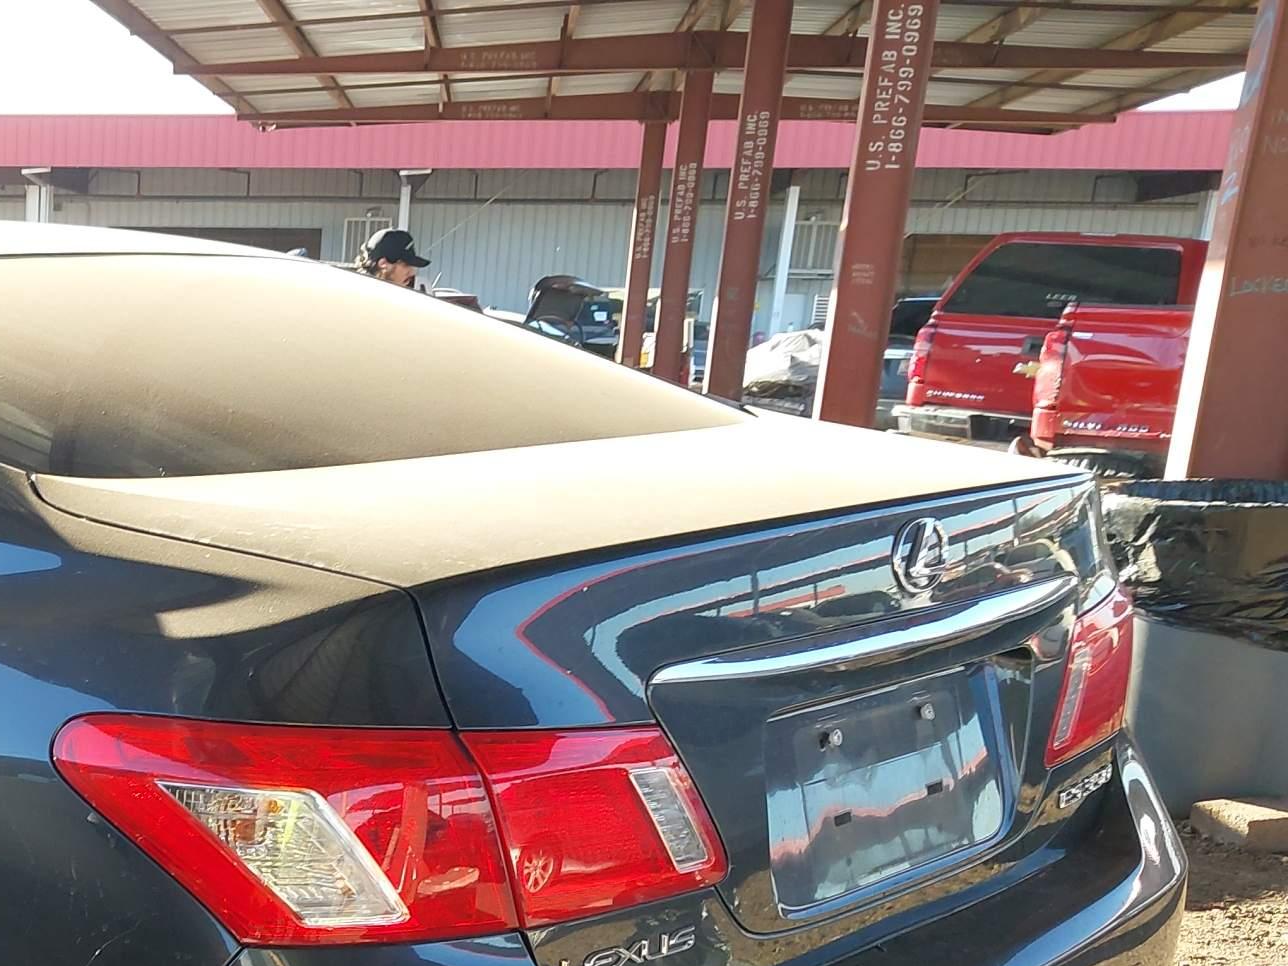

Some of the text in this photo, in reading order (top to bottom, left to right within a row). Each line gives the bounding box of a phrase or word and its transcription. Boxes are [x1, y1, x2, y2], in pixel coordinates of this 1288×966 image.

[865, 3, 905, 171] U.S. PREFAB INC.
[885, 4, 924, 169] 1-866-799-0969
